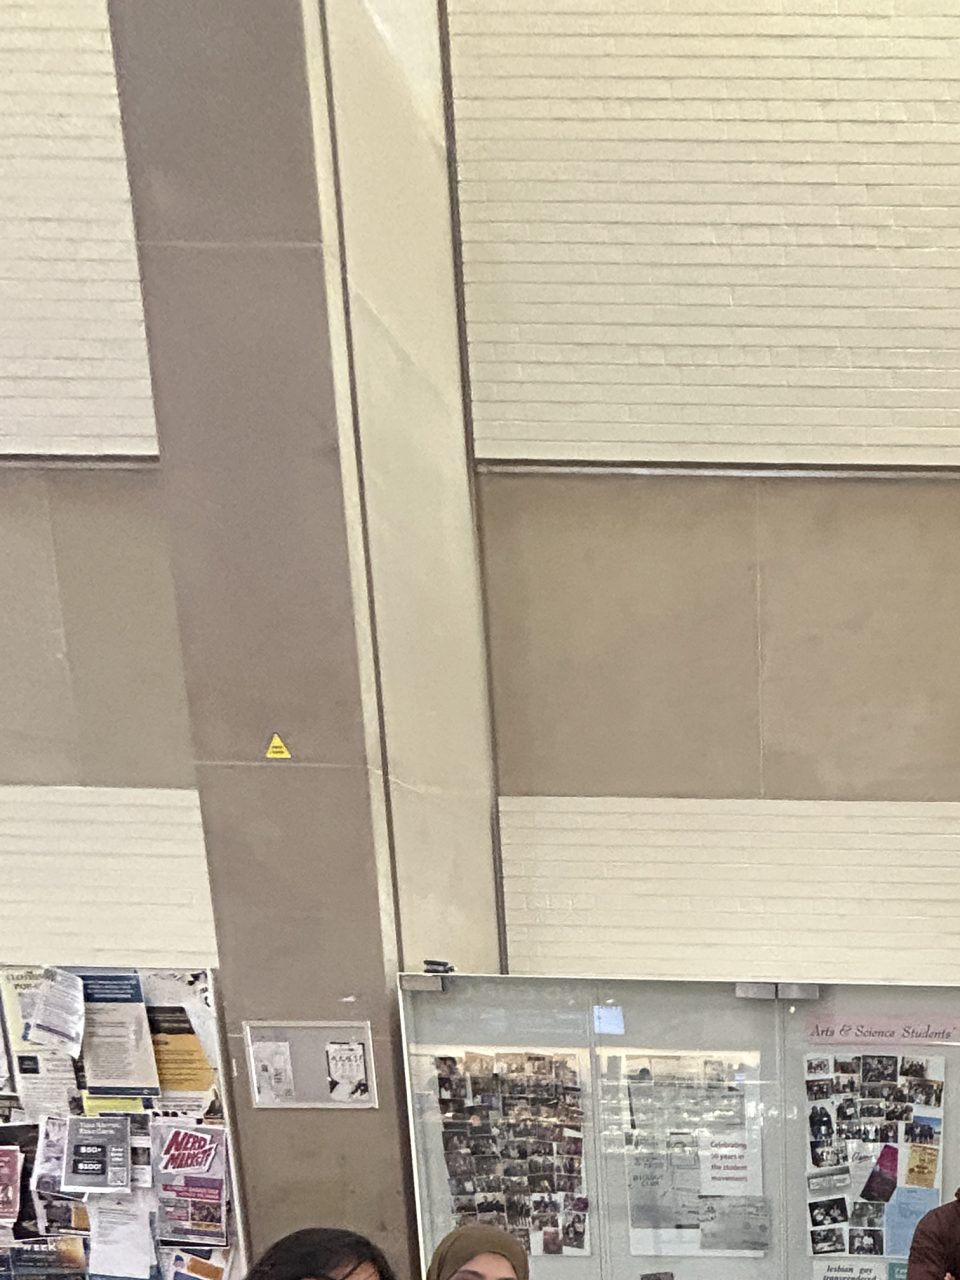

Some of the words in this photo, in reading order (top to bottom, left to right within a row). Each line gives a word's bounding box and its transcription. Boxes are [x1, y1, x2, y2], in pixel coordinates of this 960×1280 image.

[811, 1024, 835, 1037] Arts
[839, 1024, 852, 1037] &
[855, 1025, 895, 1038] Science
[163, 1130, 208, 1155] NERD
[827, 1265, 854, 1273] lesbian
[859, 1266, 873, 1275] gay
